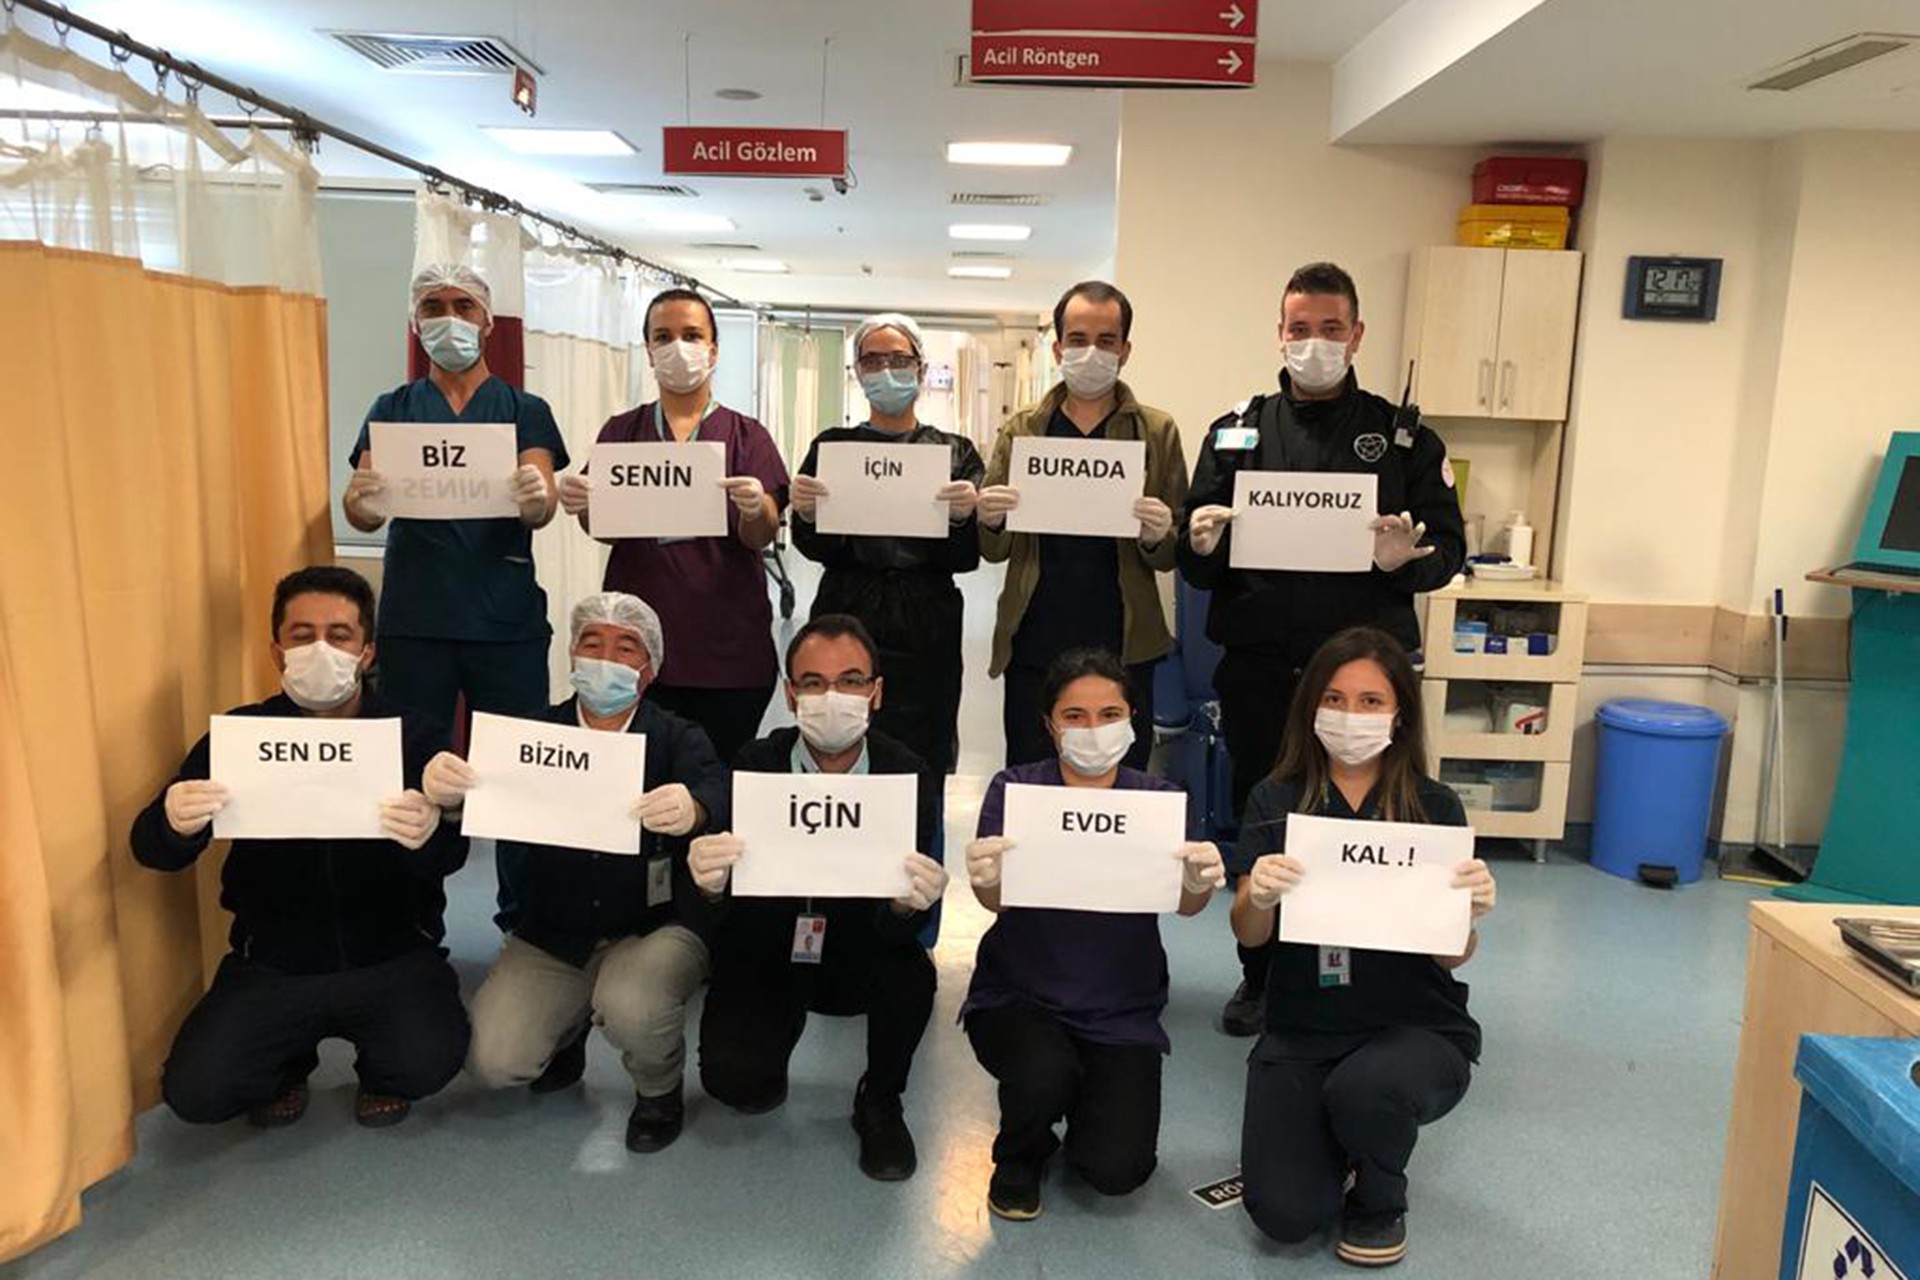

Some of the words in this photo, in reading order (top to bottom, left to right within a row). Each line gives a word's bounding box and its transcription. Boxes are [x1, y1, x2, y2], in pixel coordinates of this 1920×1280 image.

[983, 48, 1018, 65] Acil
[1023, 48, 1100, 69] Röntgen
[692, 141, 731, 161] Acil
[737, 141, 817, 162] Gözlem
[422, 440, 467, 468] BİZ
[610, 460, 692, 488] SENİN
[865, 458, 903, 480] İÇİN
[1028, 456, 1126, 480] BURADA
[1248, 490, 1362, 509] KALIYORUZ
[258, 741, 309, 762] SEN
[319, 742, 353, 762] DE
[518, 741, 590, 771] BİZİM
[788, 794, 862, 835] İÇİN
[1062, 811, 1126, 834] EVDE
[1341, 843, 1389, 866] KAL
